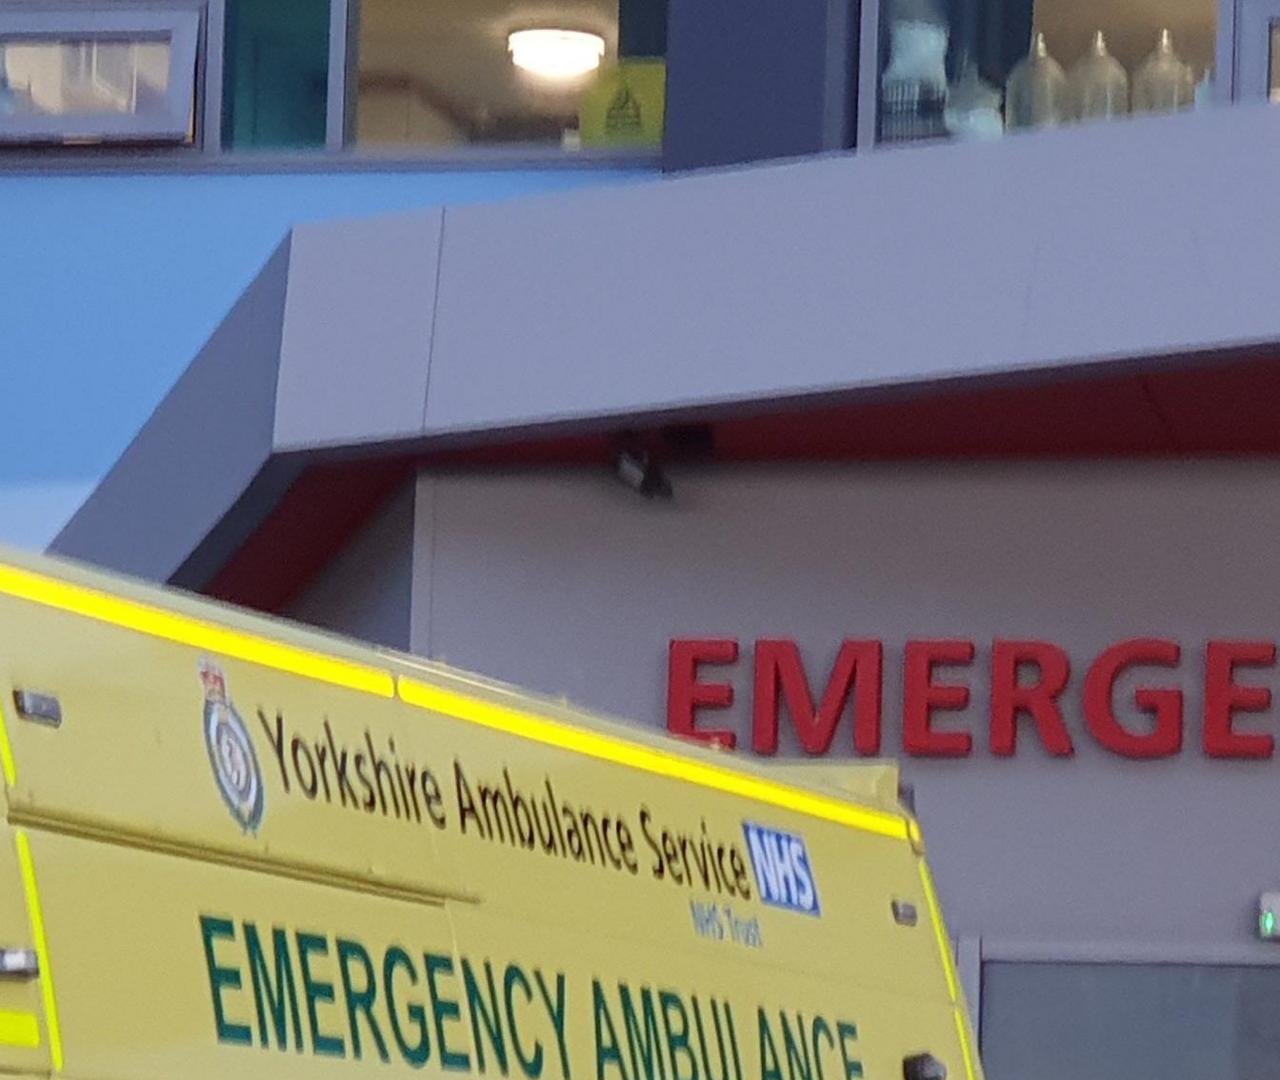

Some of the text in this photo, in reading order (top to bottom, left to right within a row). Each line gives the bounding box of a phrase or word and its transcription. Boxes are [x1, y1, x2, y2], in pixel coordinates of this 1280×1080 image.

[257, 707, 816, 912] Yorkshire Ambulance Service NHS
[689, 899, 724, 940] NHS
